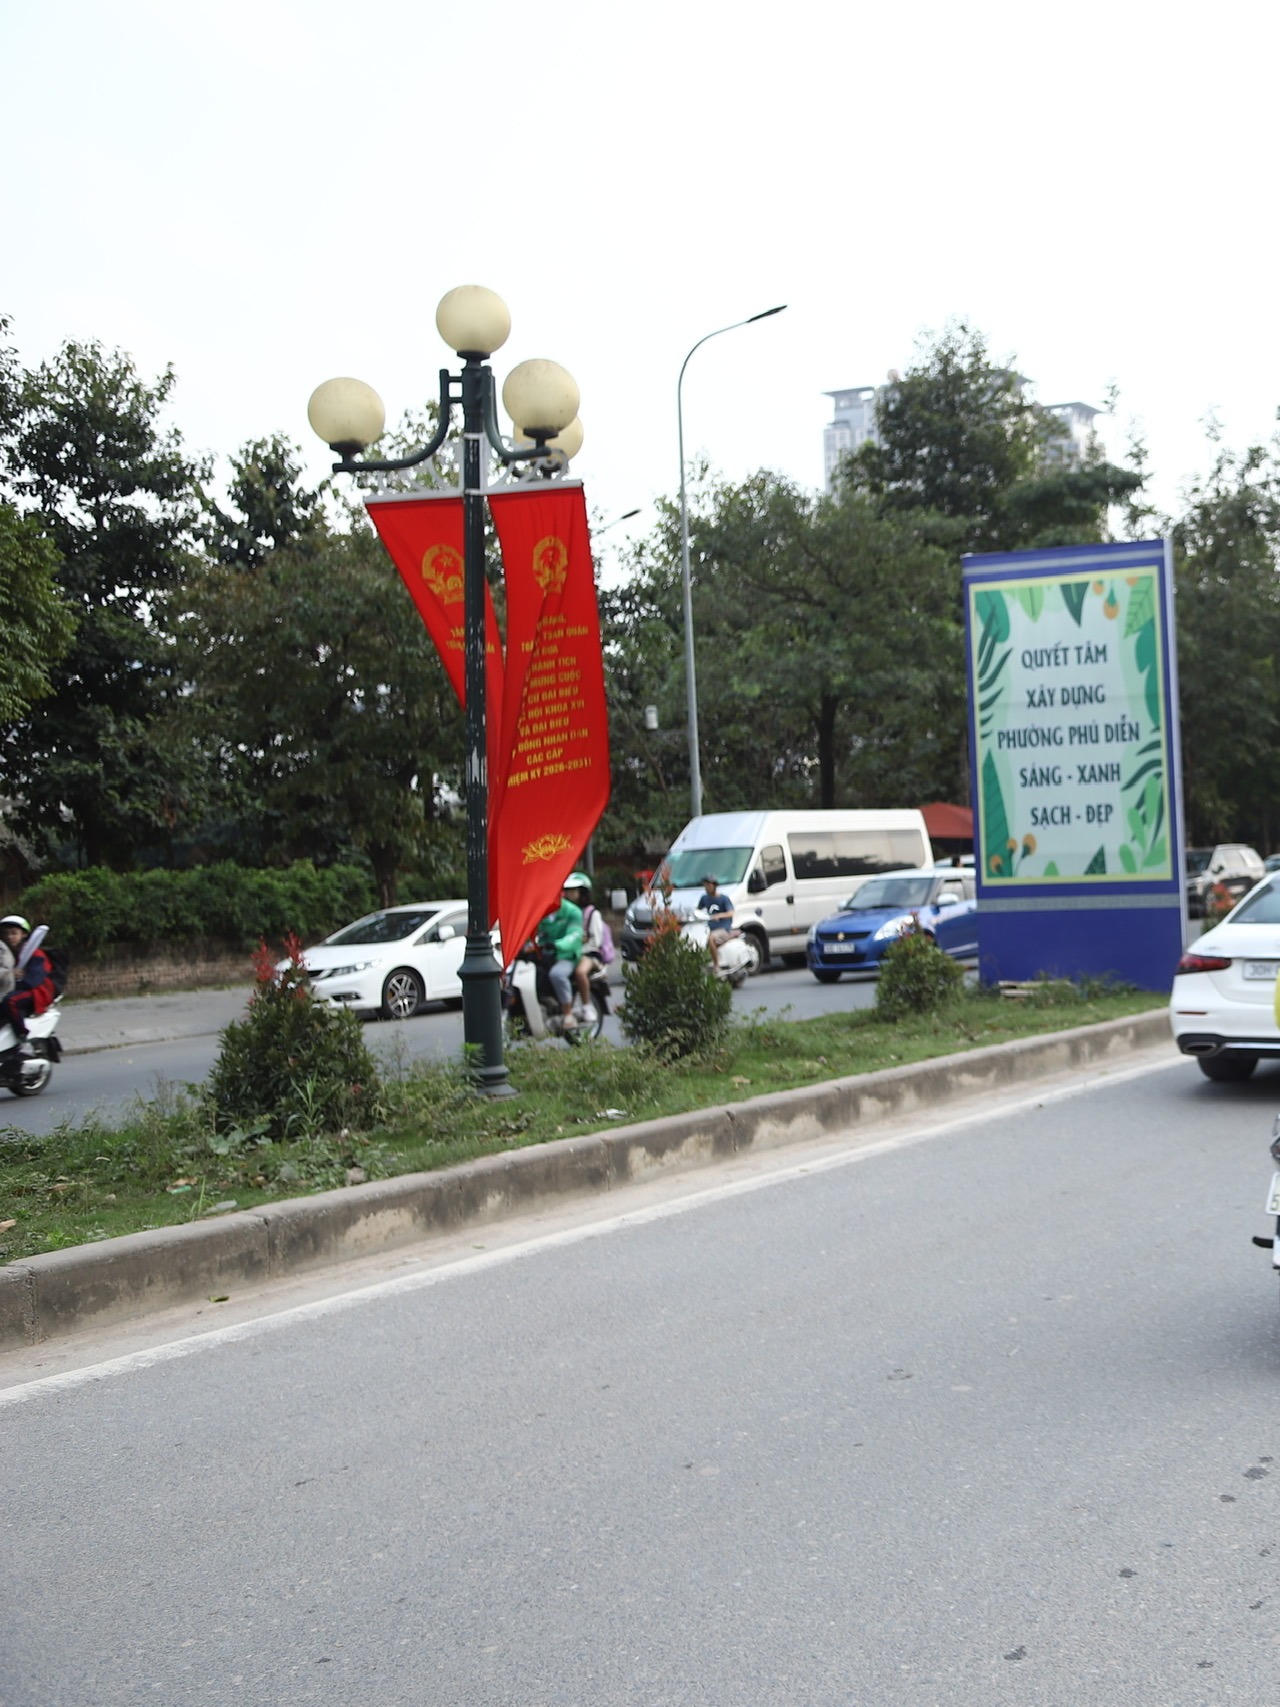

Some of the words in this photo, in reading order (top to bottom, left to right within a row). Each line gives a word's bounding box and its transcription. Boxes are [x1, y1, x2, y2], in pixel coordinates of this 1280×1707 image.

[1021, 640, 1069, 671] QUYẾT
[1026, 684, 1056, 708] XÂY
[1061, 684, 1106, 710] DỰNG
[997, 724, 1064, 750] PHƯỜNG
[1077, 762, 1121, 784] XANH
[1030, 804, 1071, 830] SẠCH
[1085, 803, 1114, 829] ĐẸP
